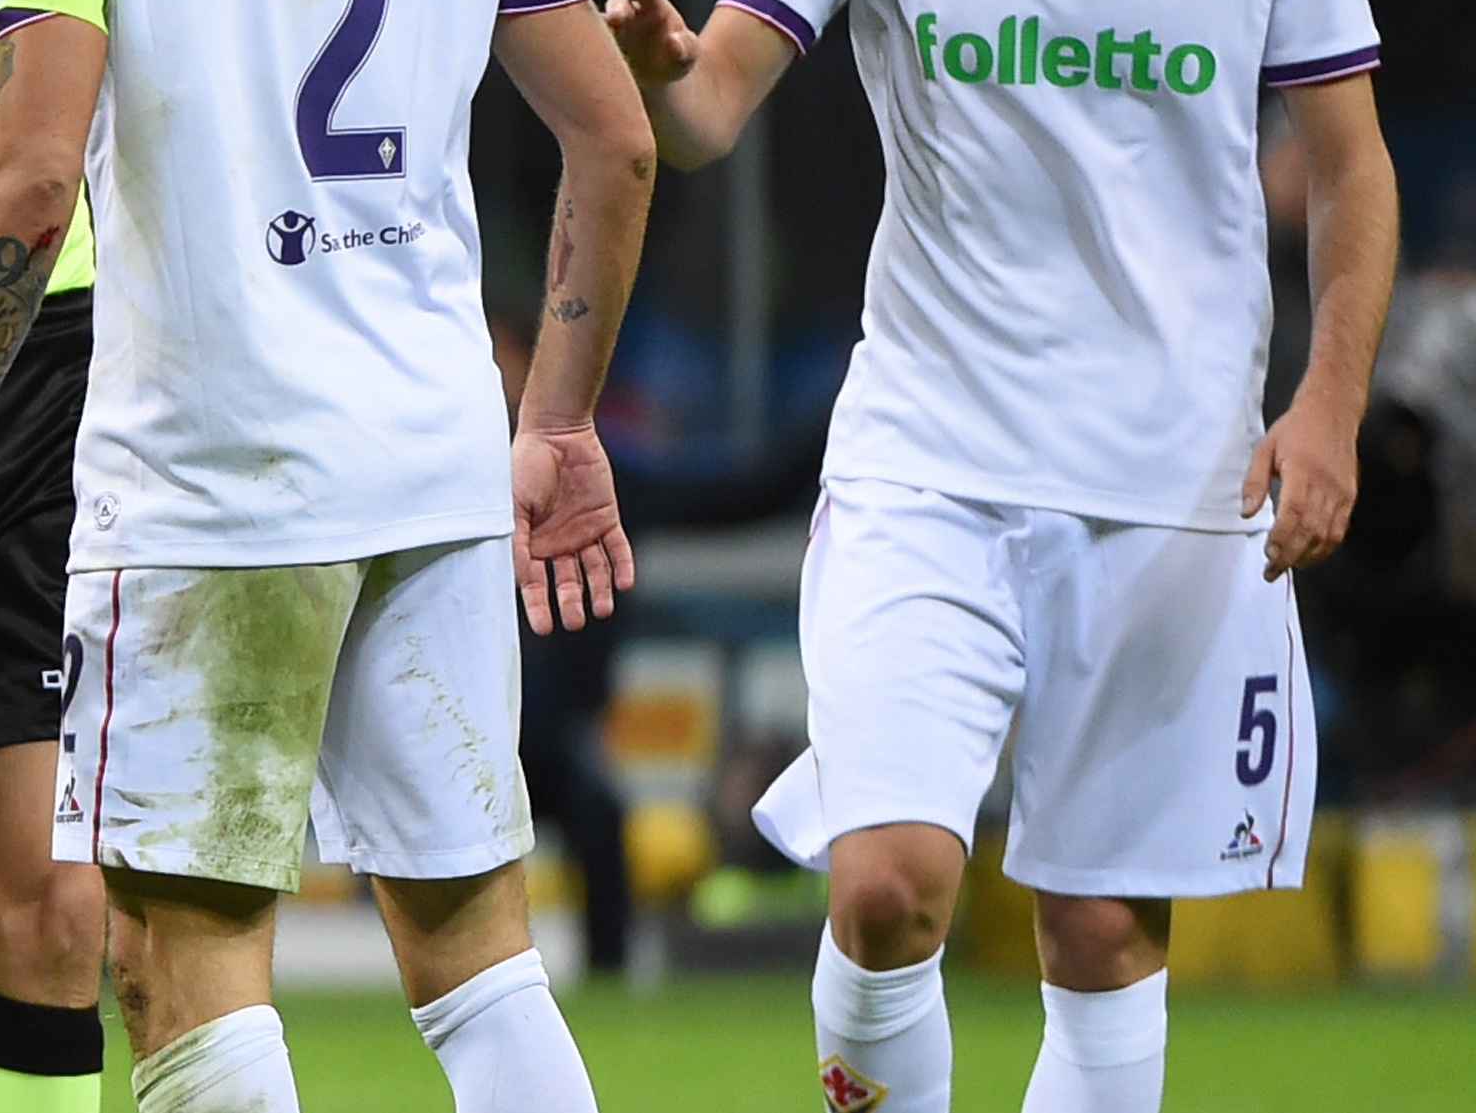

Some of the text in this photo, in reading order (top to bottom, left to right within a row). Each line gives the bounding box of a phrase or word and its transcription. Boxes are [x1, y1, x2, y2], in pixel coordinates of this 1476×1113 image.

[915, 11, 1217, 96] folletto
[343, 228, 374, 249] the
[1235, 675, 1278, 787] 5
